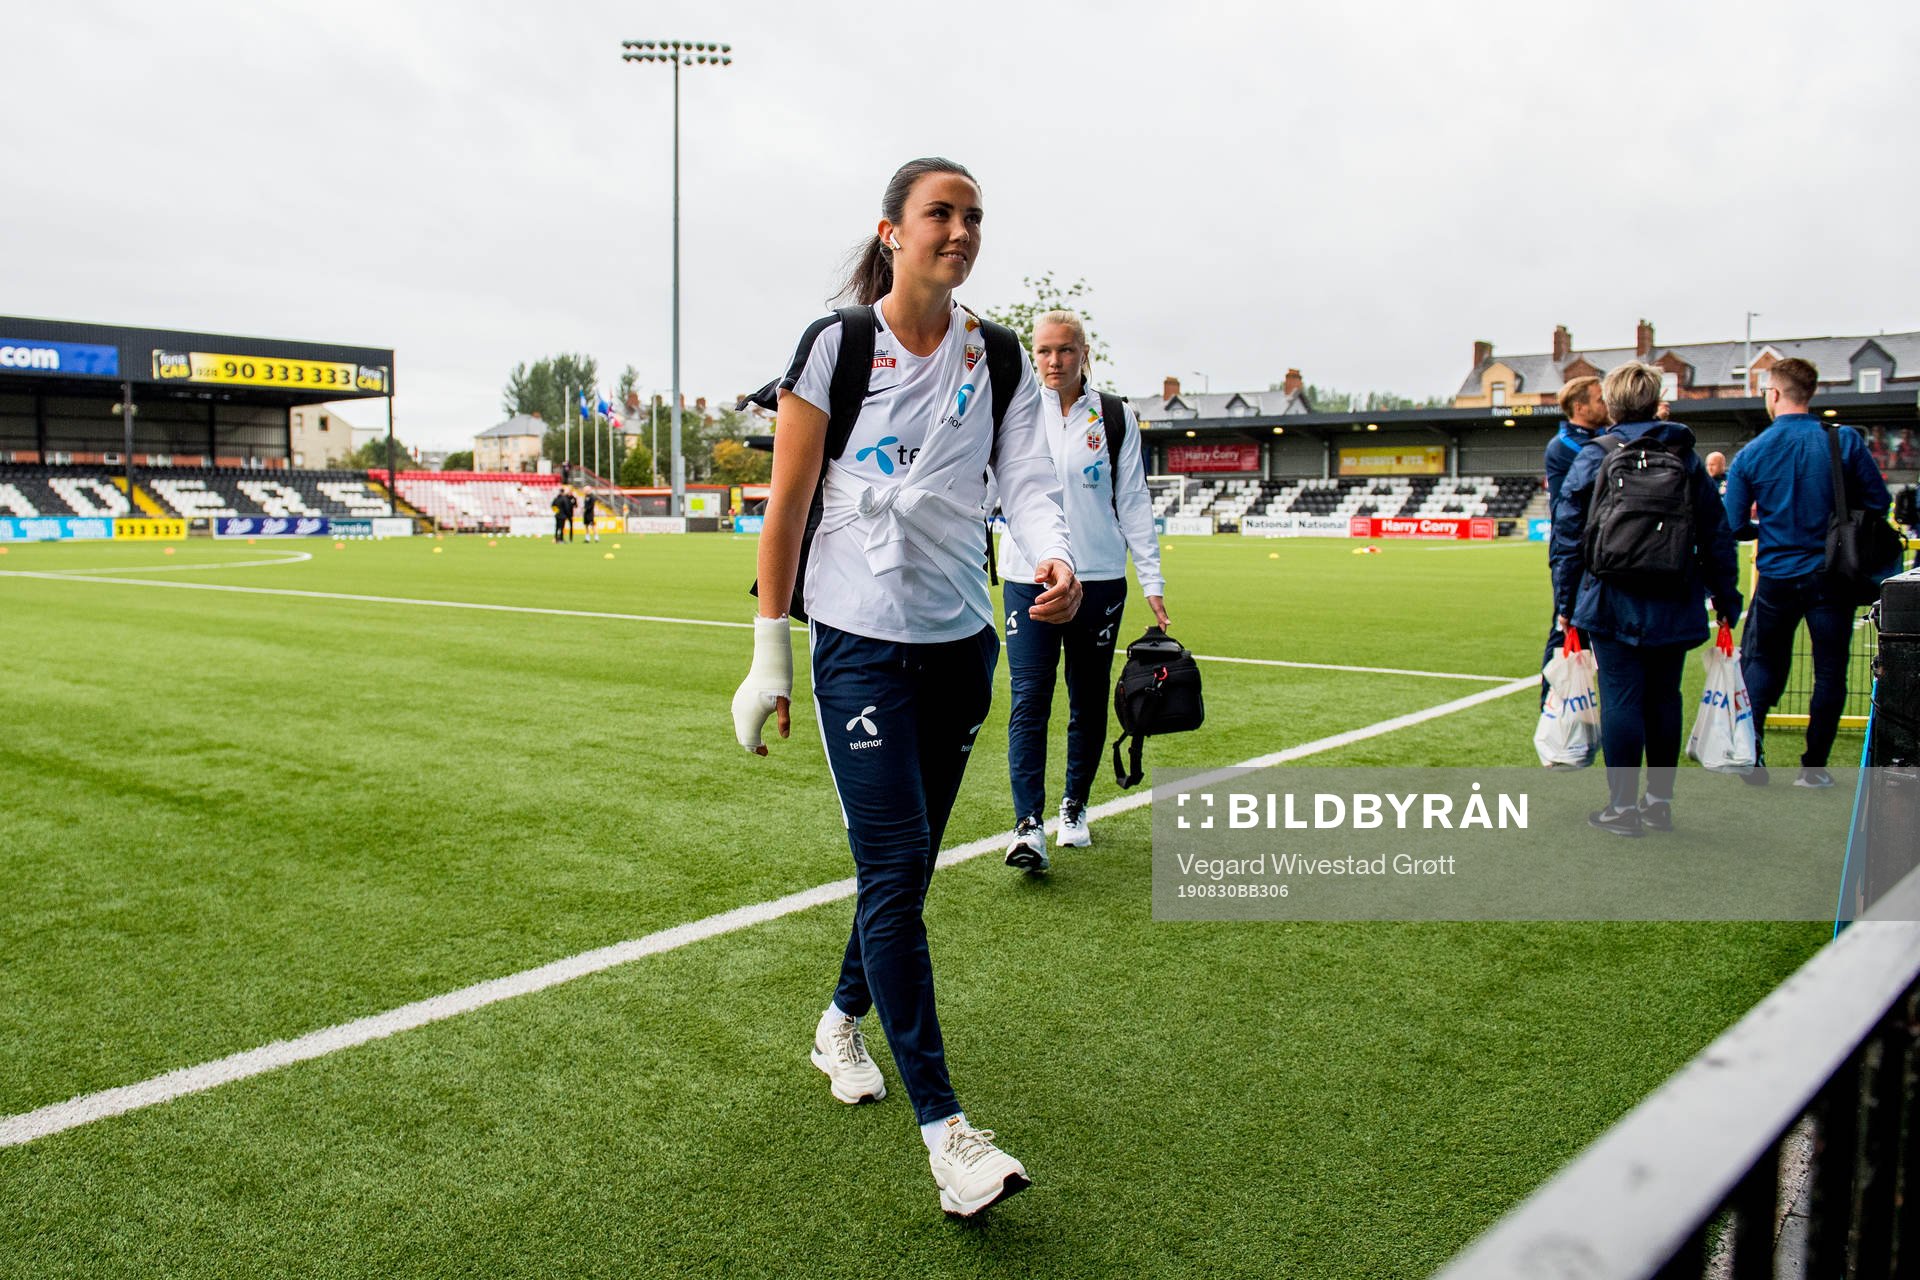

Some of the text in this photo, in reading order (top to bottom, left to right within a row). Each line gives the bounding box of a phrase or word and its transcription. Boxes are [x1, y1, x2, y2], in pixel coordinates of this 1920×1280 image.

[224, 361, 255, 379] 90
[263, 364, 304, 382] 333
[311, 367, 351, 385] 333
[1533, 405, 1560, 416] STAN
[1184, 450, 1239, 462] Harry Corry
[1246, 519, 1293, 529] National
[1299, 519, 1347, 529] National
[1381, 519, 1418, 534] Harry
[1420, 519, 1459, 535] Corry
[849, 738, 883, 751] telenor
